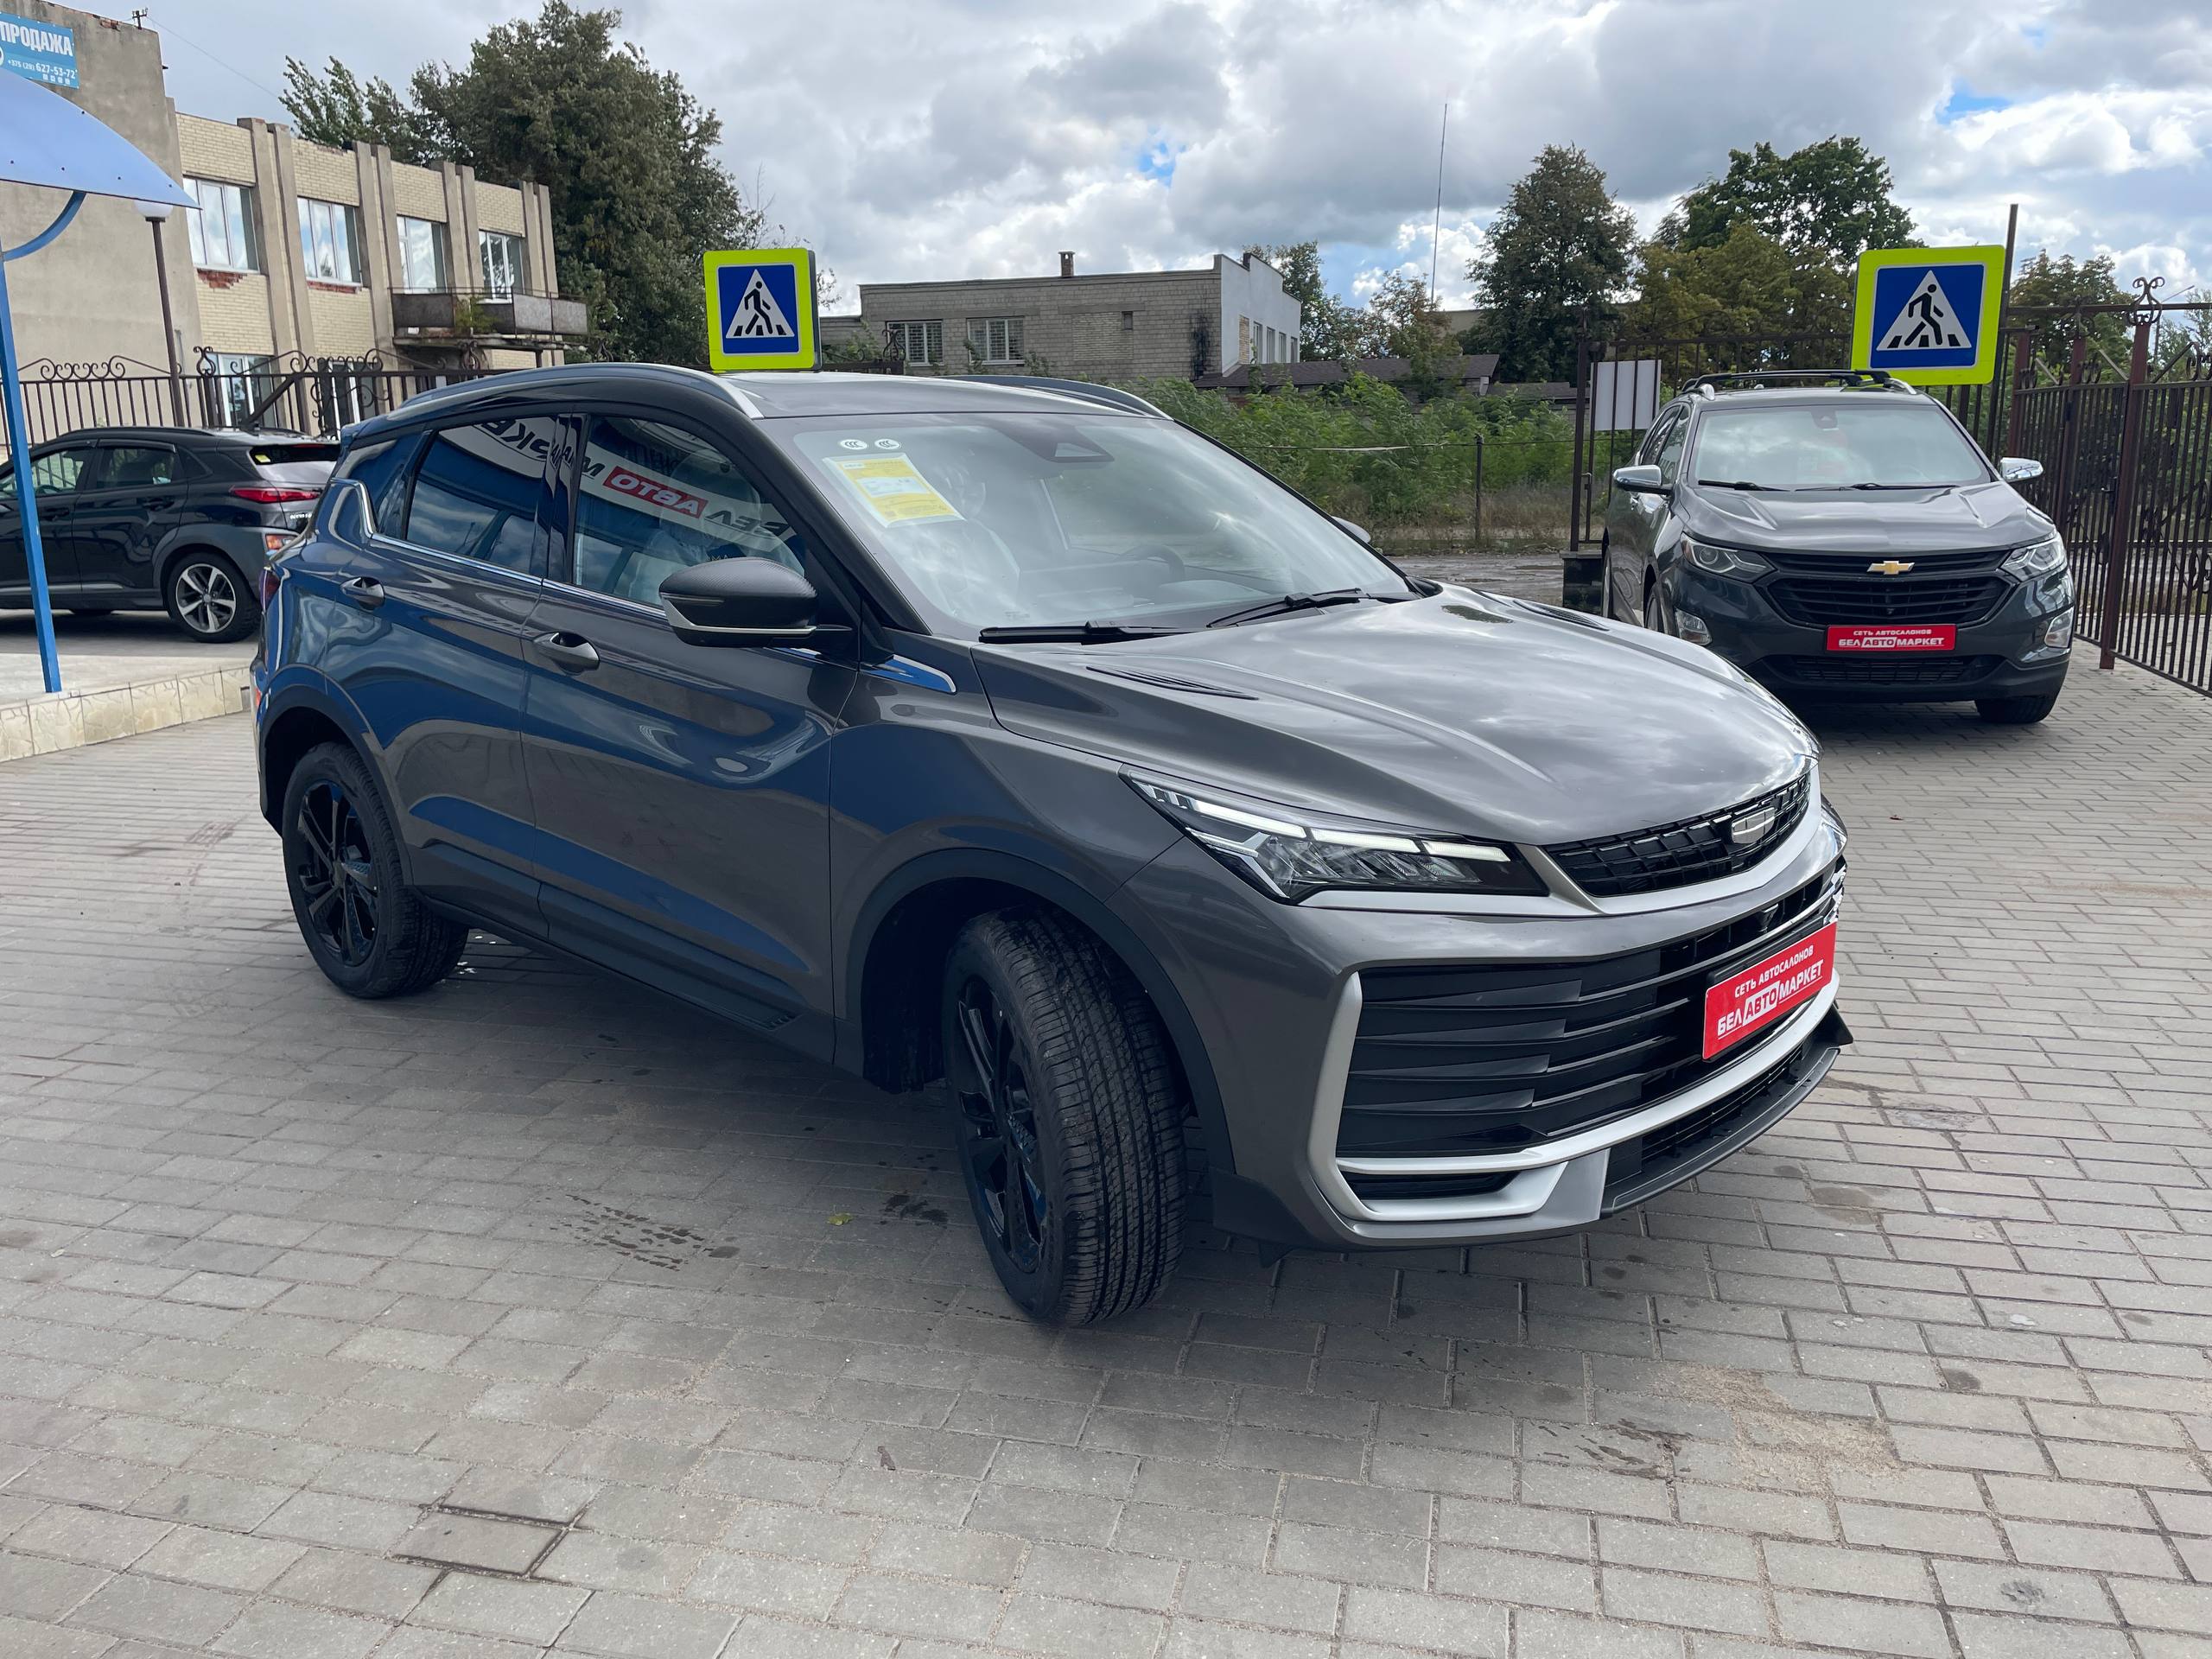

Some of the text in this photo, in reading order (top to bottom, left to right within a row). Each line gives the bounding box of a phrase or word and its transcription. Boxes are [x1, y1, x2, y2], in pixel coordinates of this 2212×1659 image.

[0, 21, 73, 57] ПРОДАЖА
[35, 62, 76, 79] 627-53-72
[1734, 944, 1814, 998] СЕТЬ АВТОСАЛОНОВ
